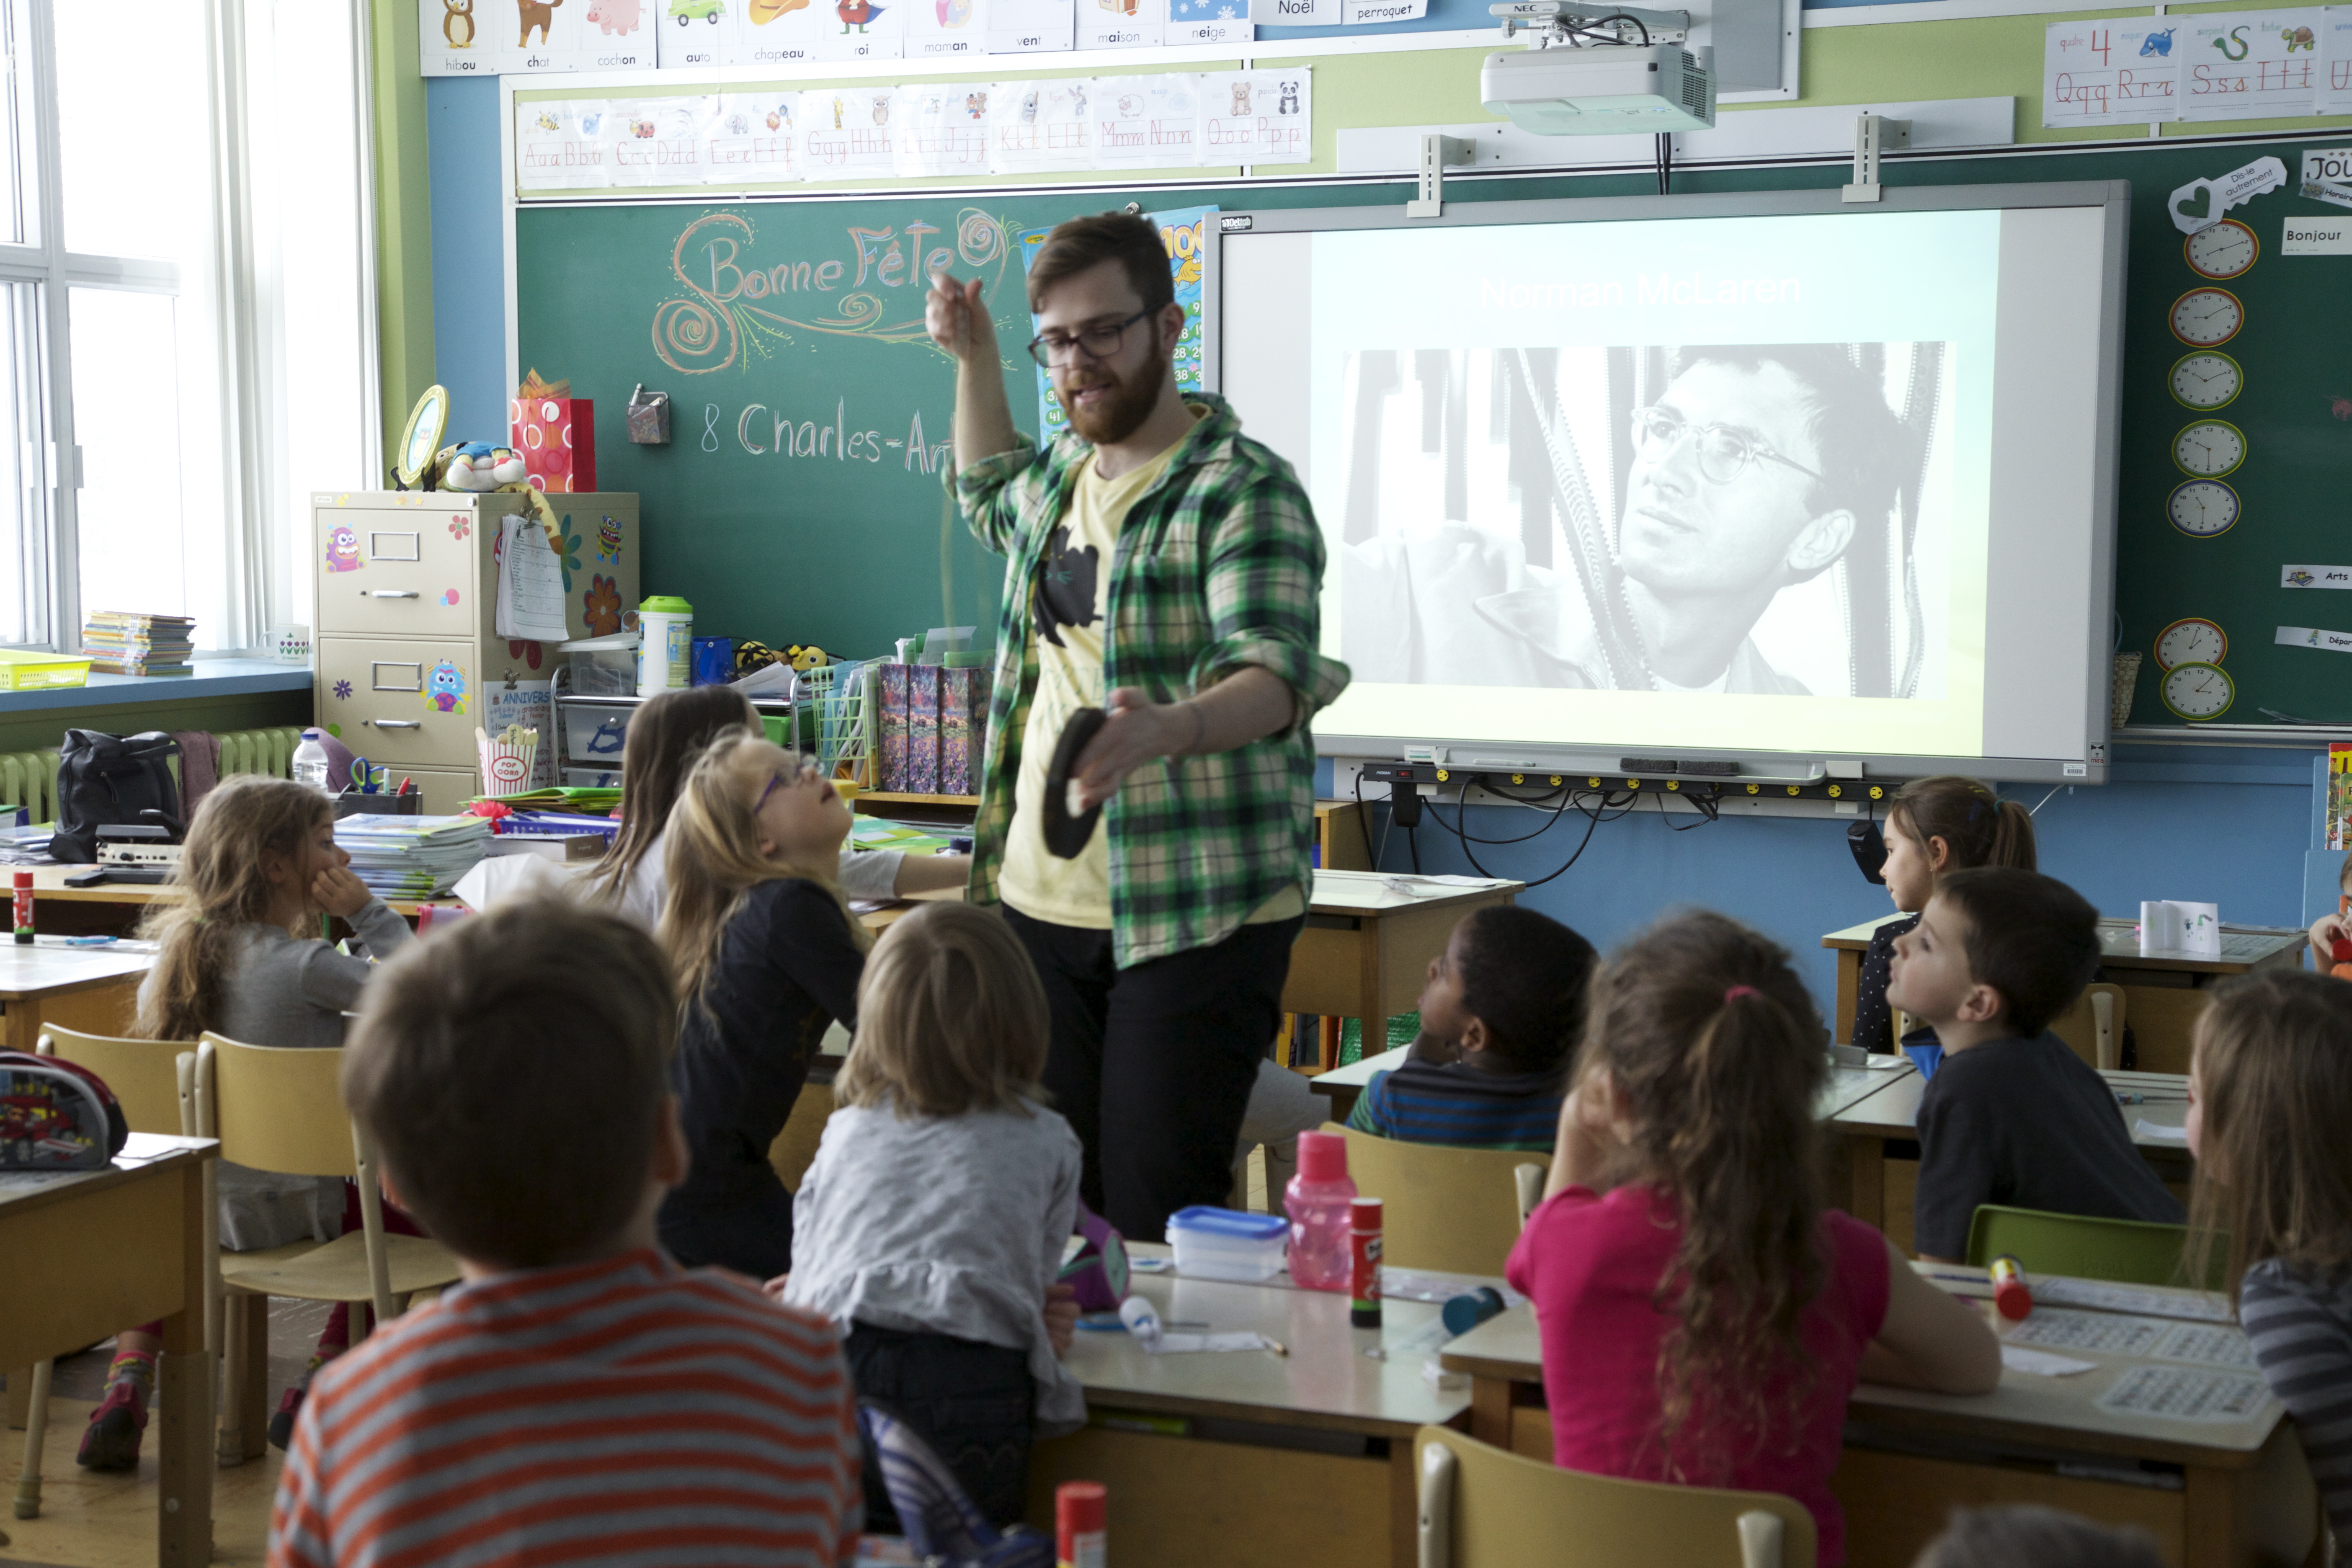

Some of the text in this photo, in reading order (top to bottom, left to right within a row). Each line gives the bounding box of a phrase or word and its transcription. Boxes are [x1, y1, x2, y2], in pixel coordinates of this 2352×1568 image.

[1279, 0, 1314, 14] Noël
[1358, 4, 1413, 21] perroquet
[1098, 31, 1140, 43] maison
[1192, 26, 1226, 41] neige
[925, 41, 967, 52] maman
[1017, 35, 1041, 46] vent
[754, 48, 804, 61] chapeau
[854, 44, 869, 55] roi
[2092, 30, 2111, 66] 4
[527, 55, 549, 68] chat
[598, 54, 636, 67] cochon
[686, 52, 710, 63] auto
[446, 58, 476, 71] hibou
[1258, 86, 1277, 99] panda
[2231, 167, 2255, 183] Dis-le
[2226, 168, 2272, 196] autrement
[2287, 231, 2341, 242] Bonjour
[701, 237, 844, 302] Bonne
[1480, 271, 1801, 308] Norman McLaren
[1193, 302, 1200, 313] 9
[1173, 348, 1186, 359] 28
[1175, 370, 1189, 381] 38
[1049, 411, 1060, 422] 41
[701, 403, 720, 452] 8
[503, 691, 549, 704] ANNIVERS
